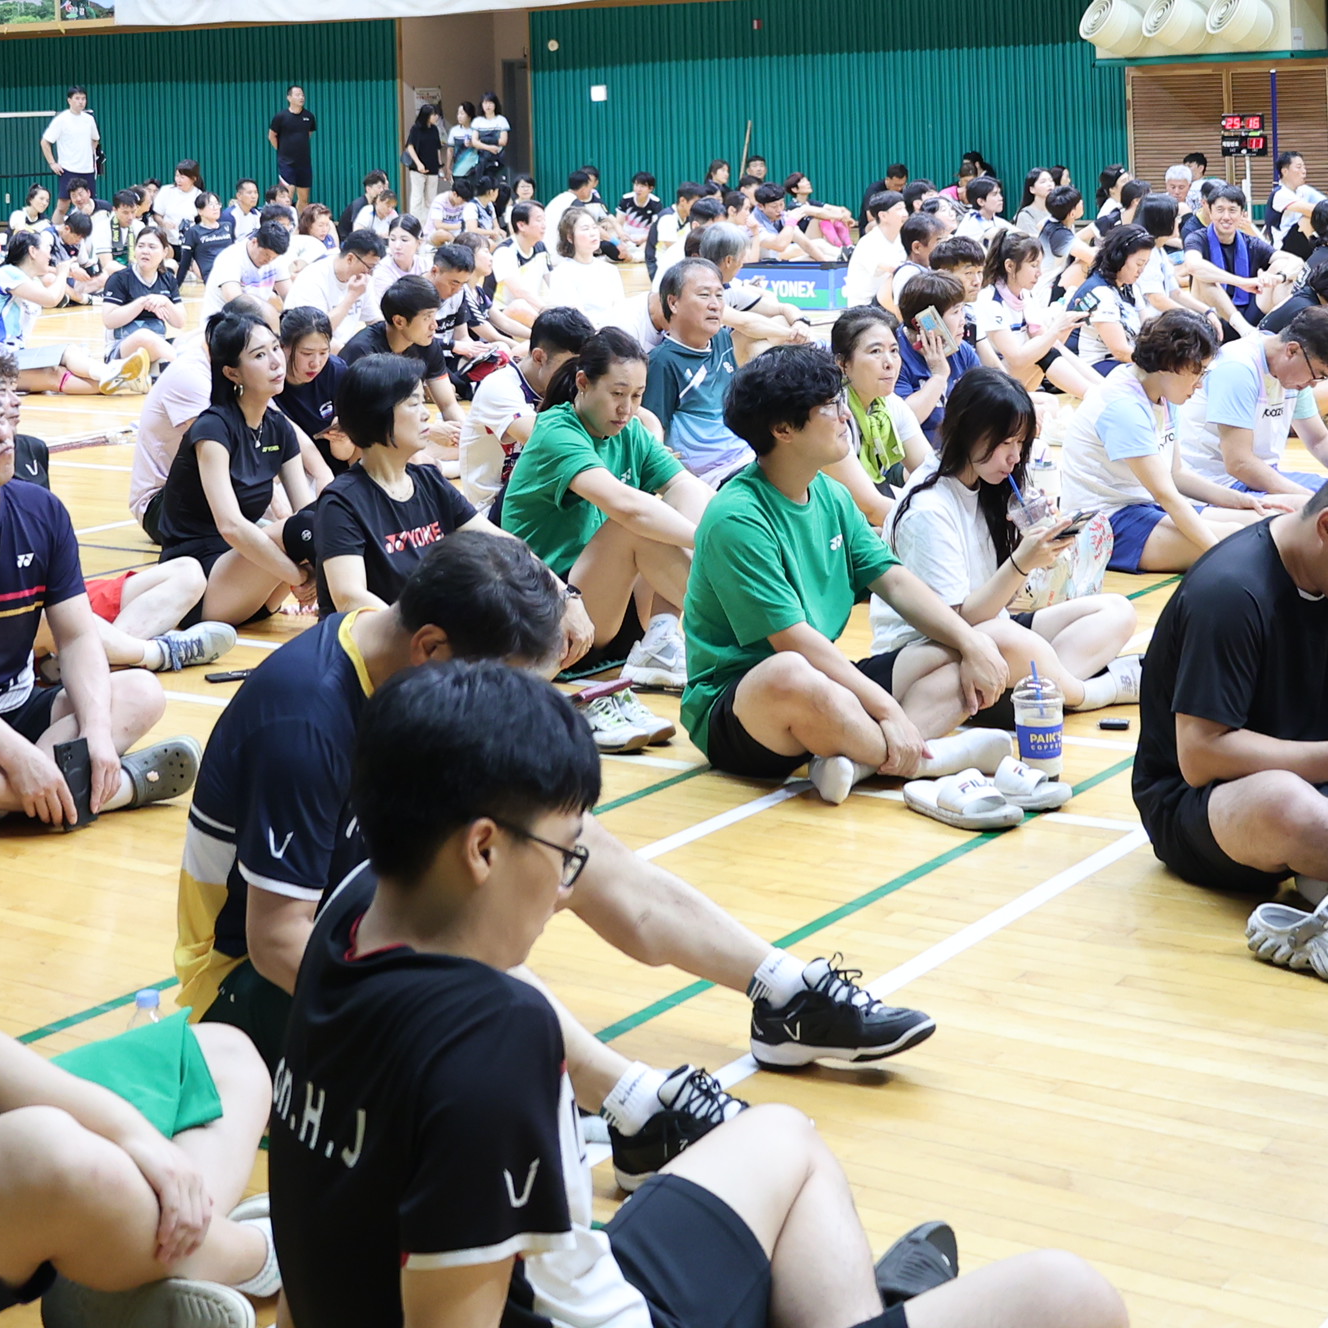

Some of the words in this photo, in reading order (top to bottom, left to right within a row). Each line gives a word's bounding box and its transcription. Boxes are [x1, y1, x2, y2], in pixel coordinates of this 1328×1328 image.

[1225, 116, 1241, 129] 25
[770, 280, 817, 299] YONEX
[408, 521, 444, 549] YONE
